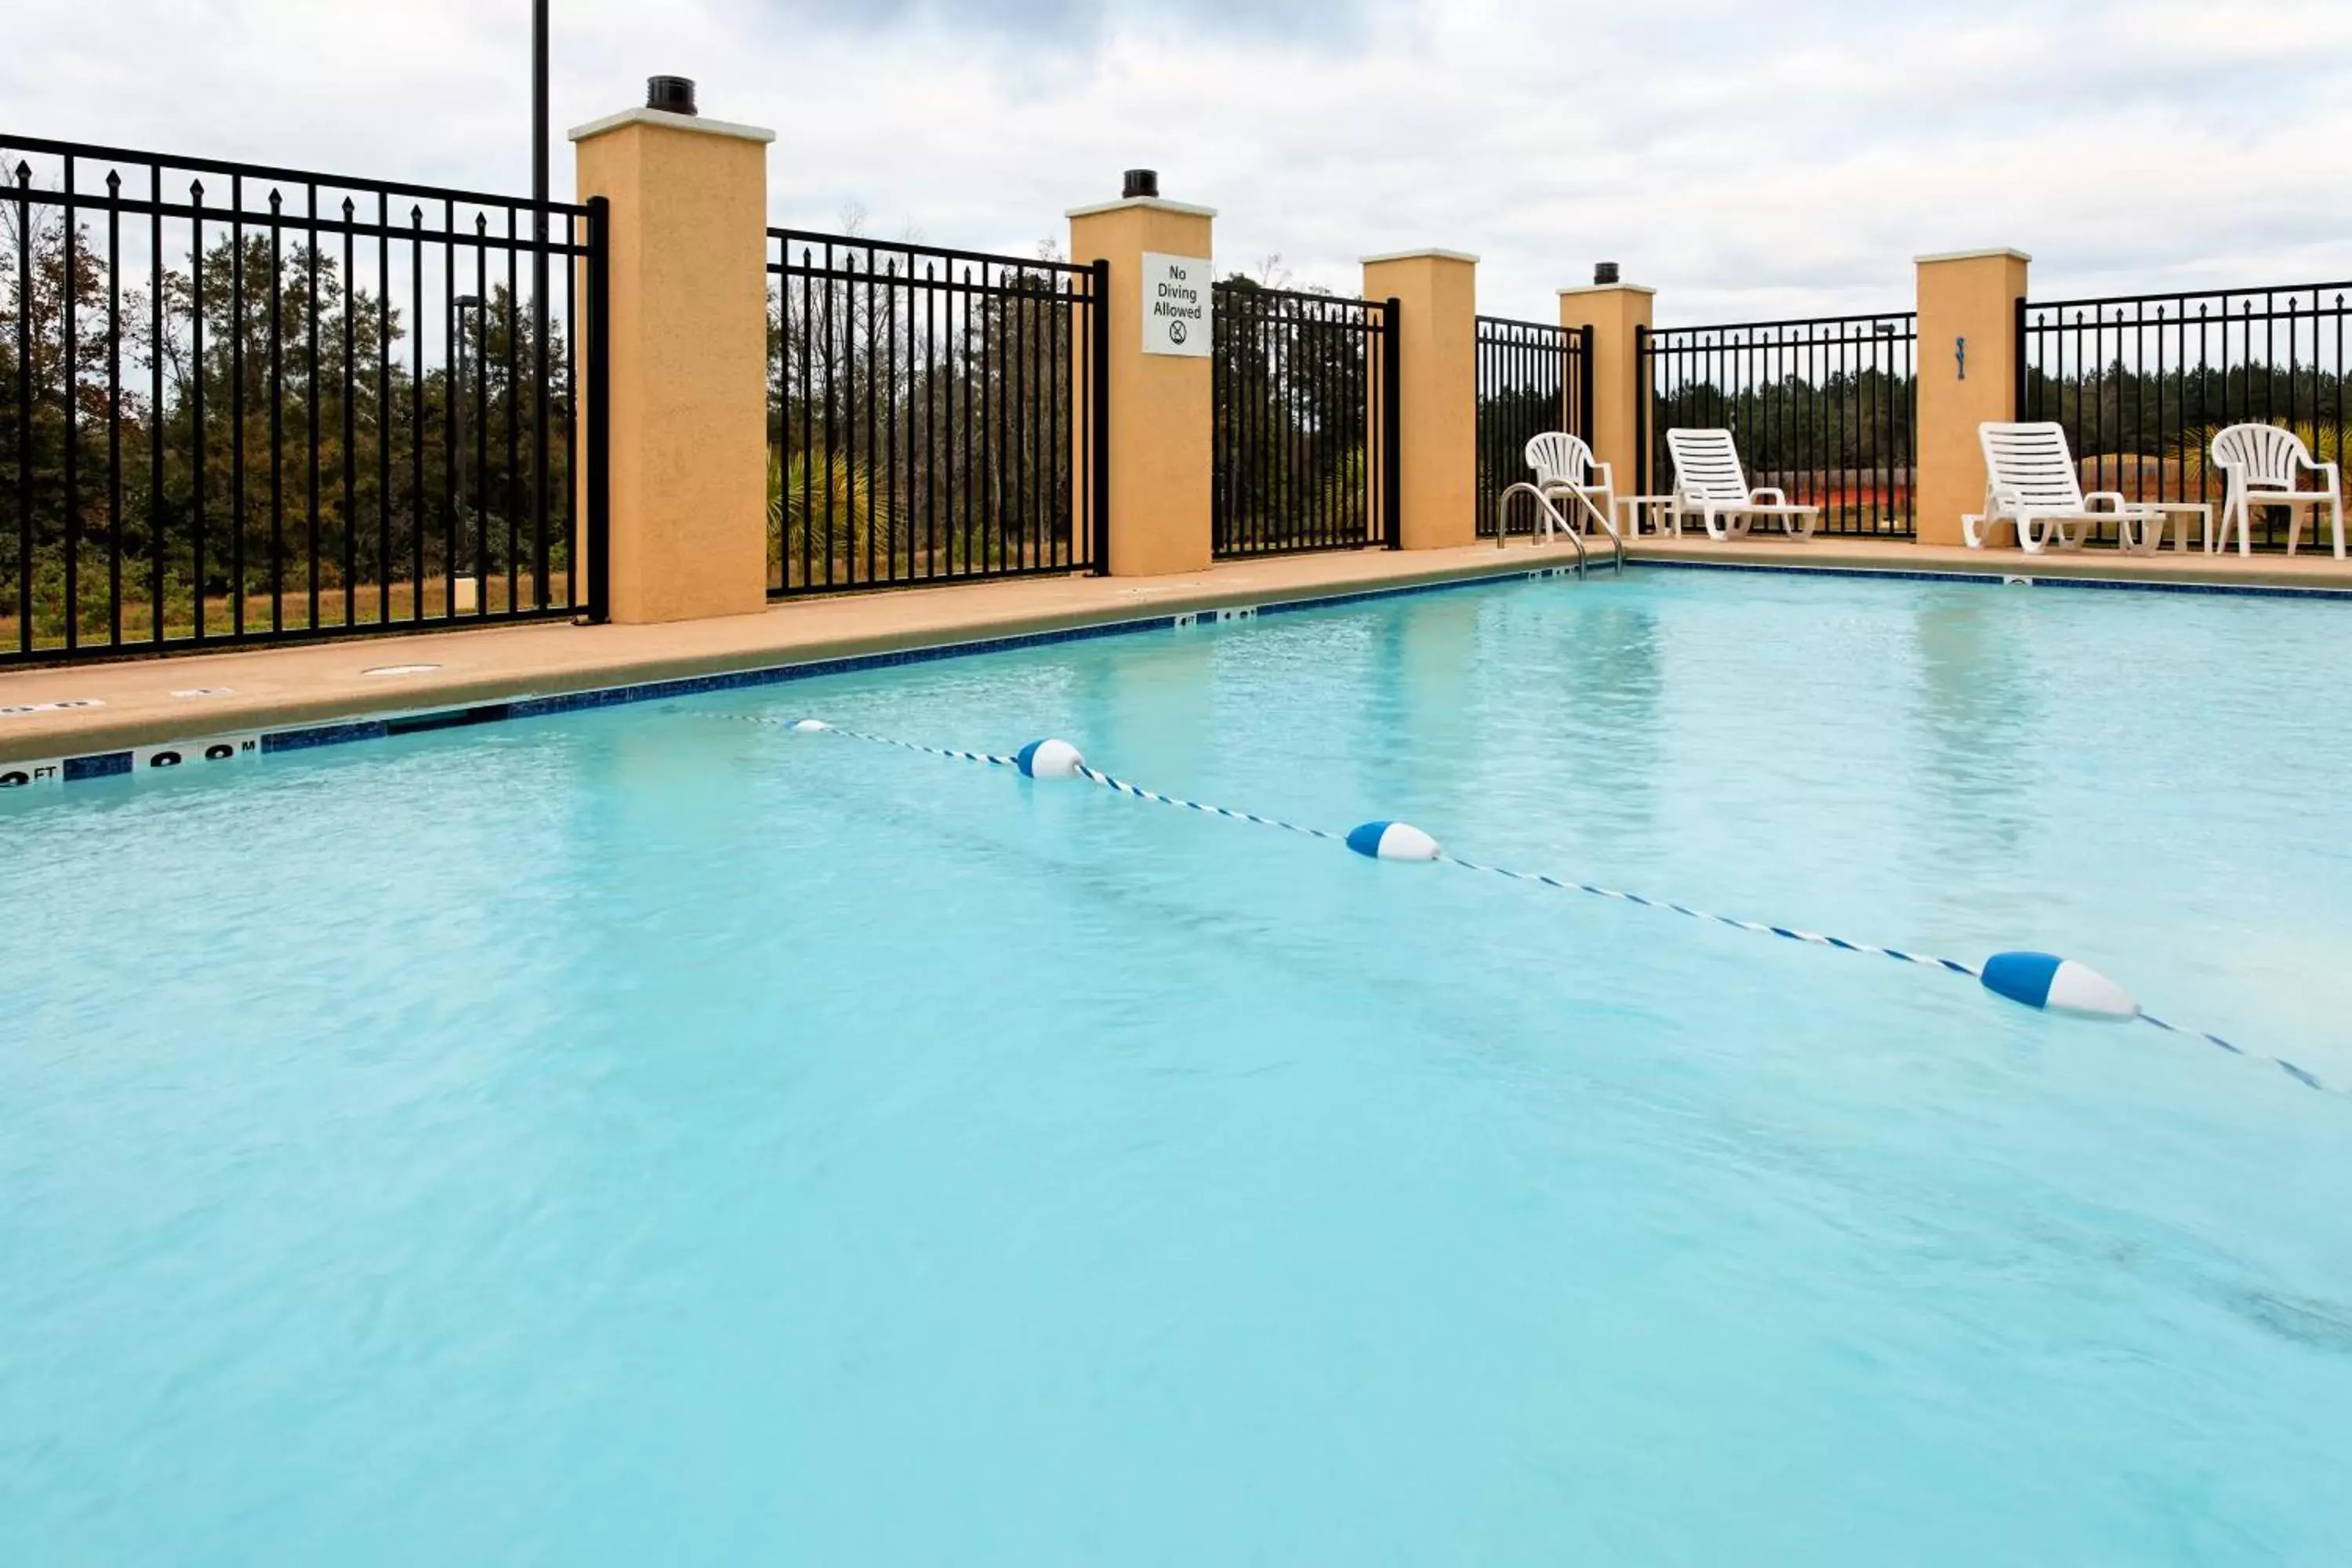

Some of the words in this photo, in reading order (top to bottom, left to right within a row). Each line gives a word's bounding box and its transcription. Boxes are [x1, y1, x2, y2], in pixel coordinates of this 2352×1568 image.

[1170, 265, 1185, 280] No
[1158, 283, 1196, 303] Diving
[1154, 301, 1201, 318] Allowed
[34, 767, 56, 779] FT
